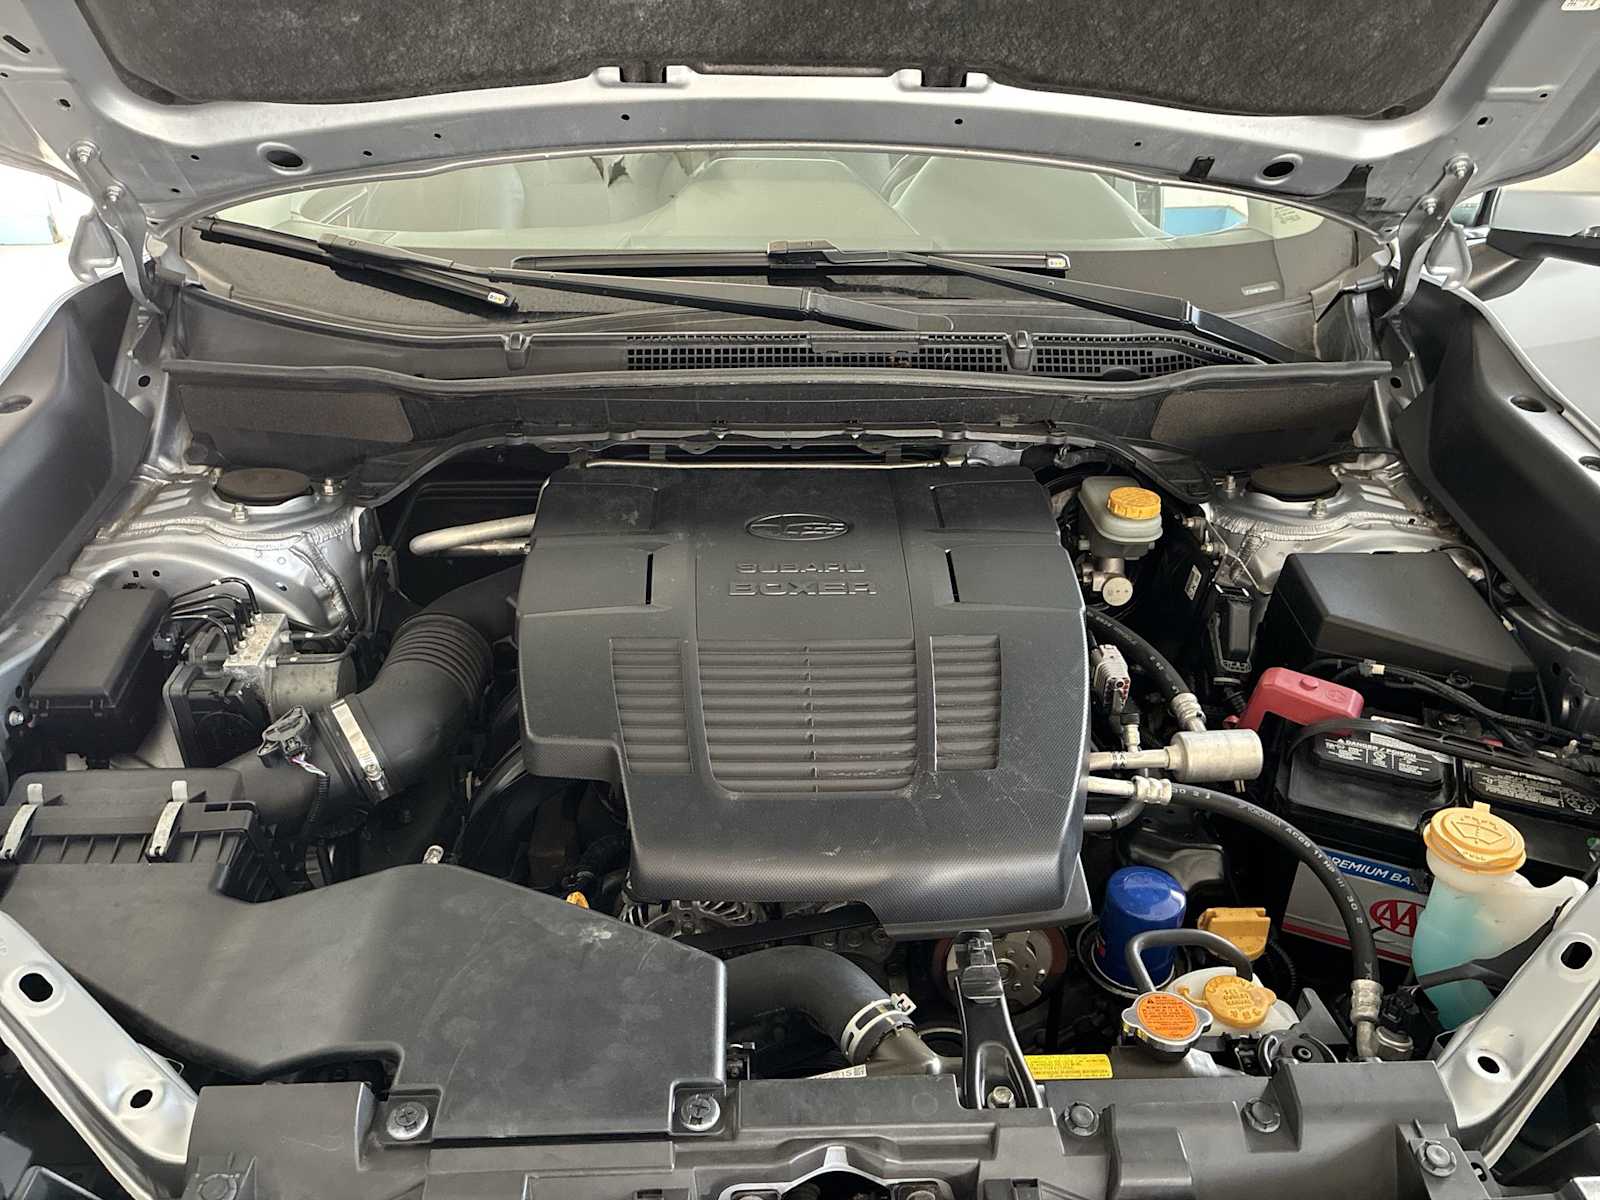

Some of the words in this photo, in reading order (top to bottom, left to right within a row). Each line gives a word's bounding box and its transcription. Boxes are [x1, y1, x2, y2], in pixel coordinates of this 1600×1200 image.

[736, 561, 865, 573] SUBARU
[728, 582, 877, 596] BOXER
[1328, 855, 1389, 879] REMIUM
[1390, 872, 1415, 887] BA
